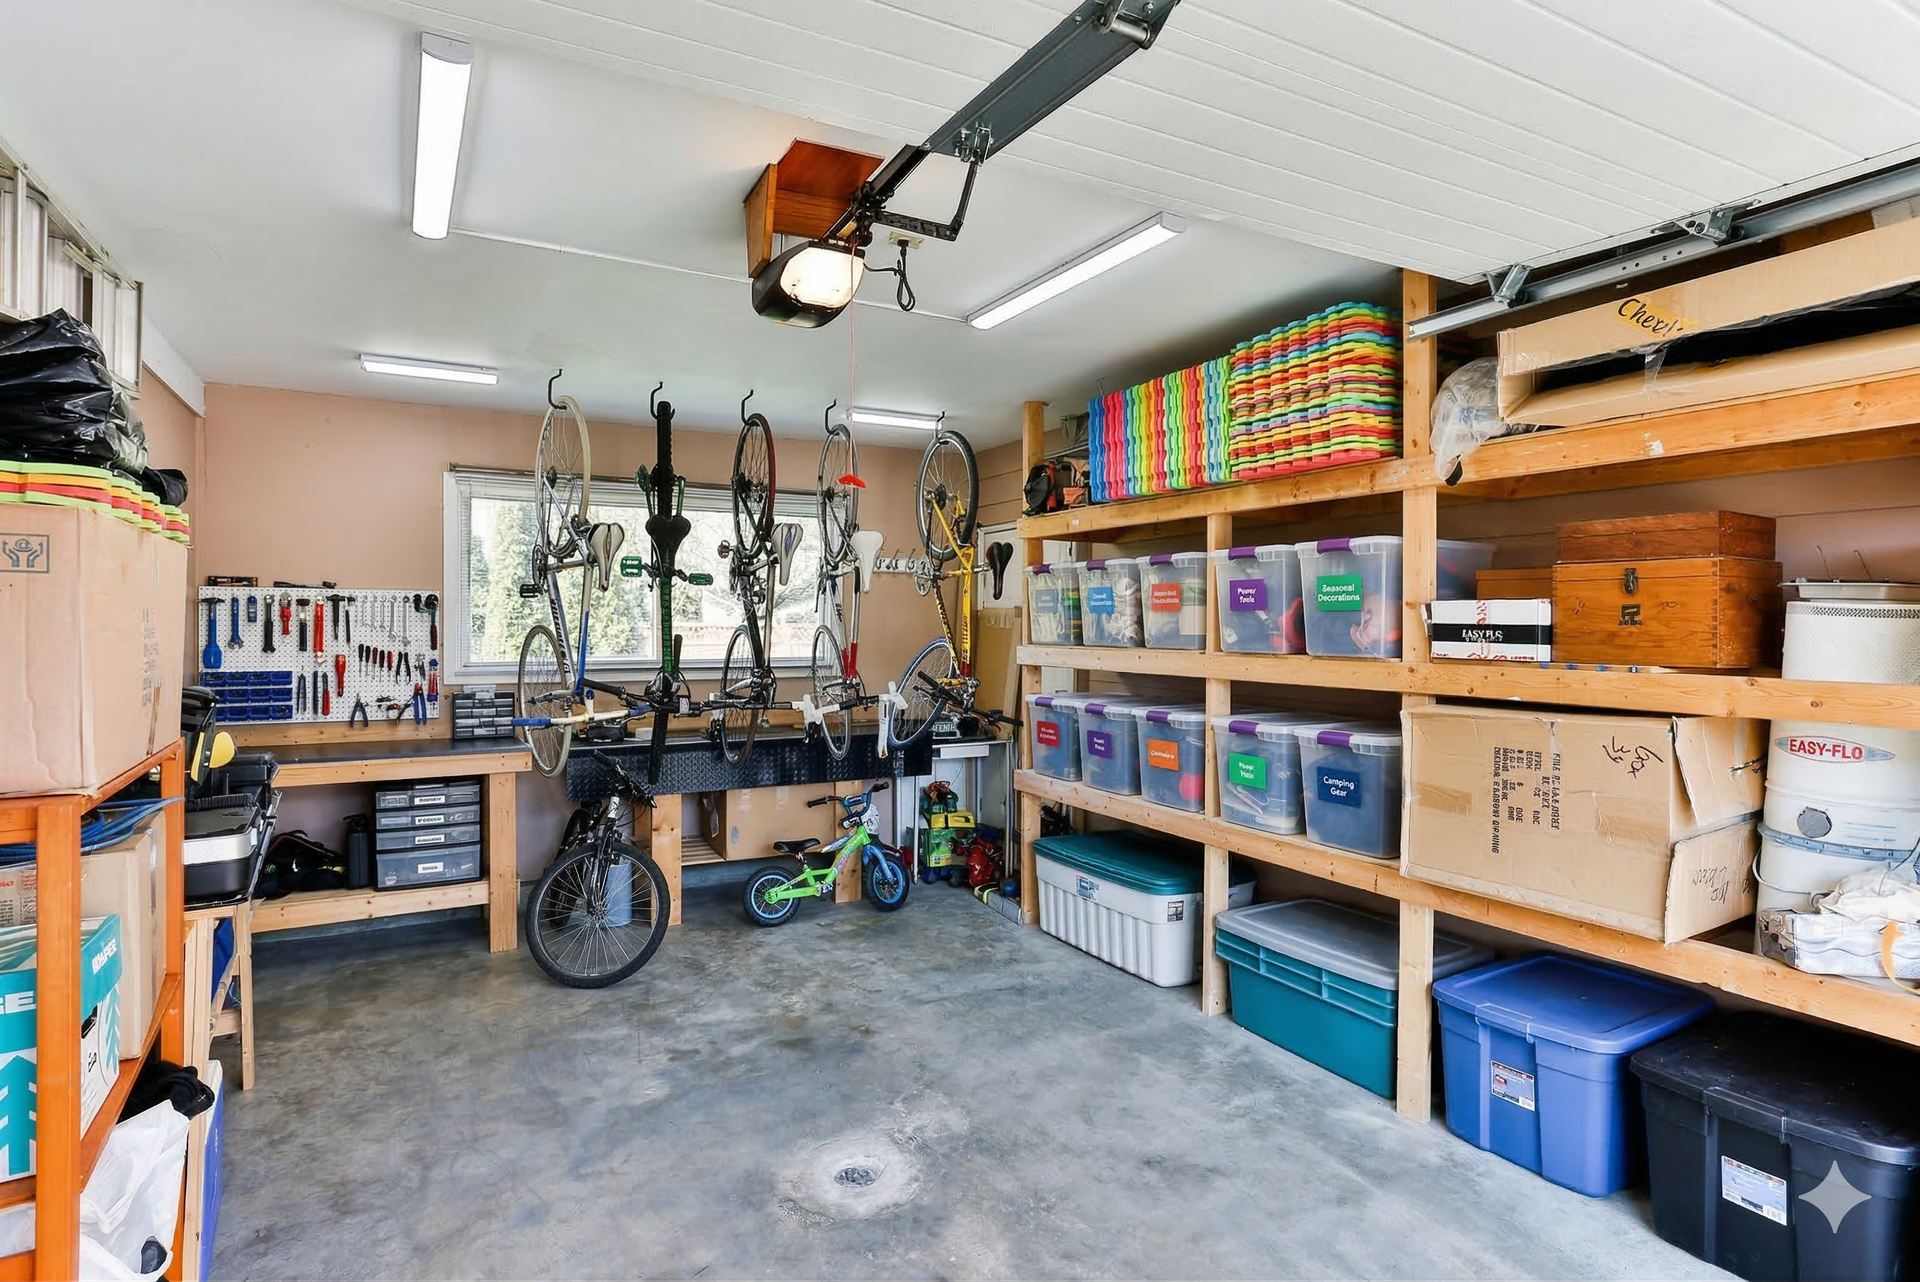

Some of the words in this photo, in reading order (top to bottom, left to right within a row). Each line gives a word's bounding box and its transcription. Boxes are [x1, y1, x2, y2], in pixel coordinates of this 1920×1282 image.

[1317, 593, 1361, 602] Decorations
[1788, 738, 1864, 760] EASY-FLO
[1323, 775, 1355, 790] Camping
[1330, 787, 1348, 797] Gear
